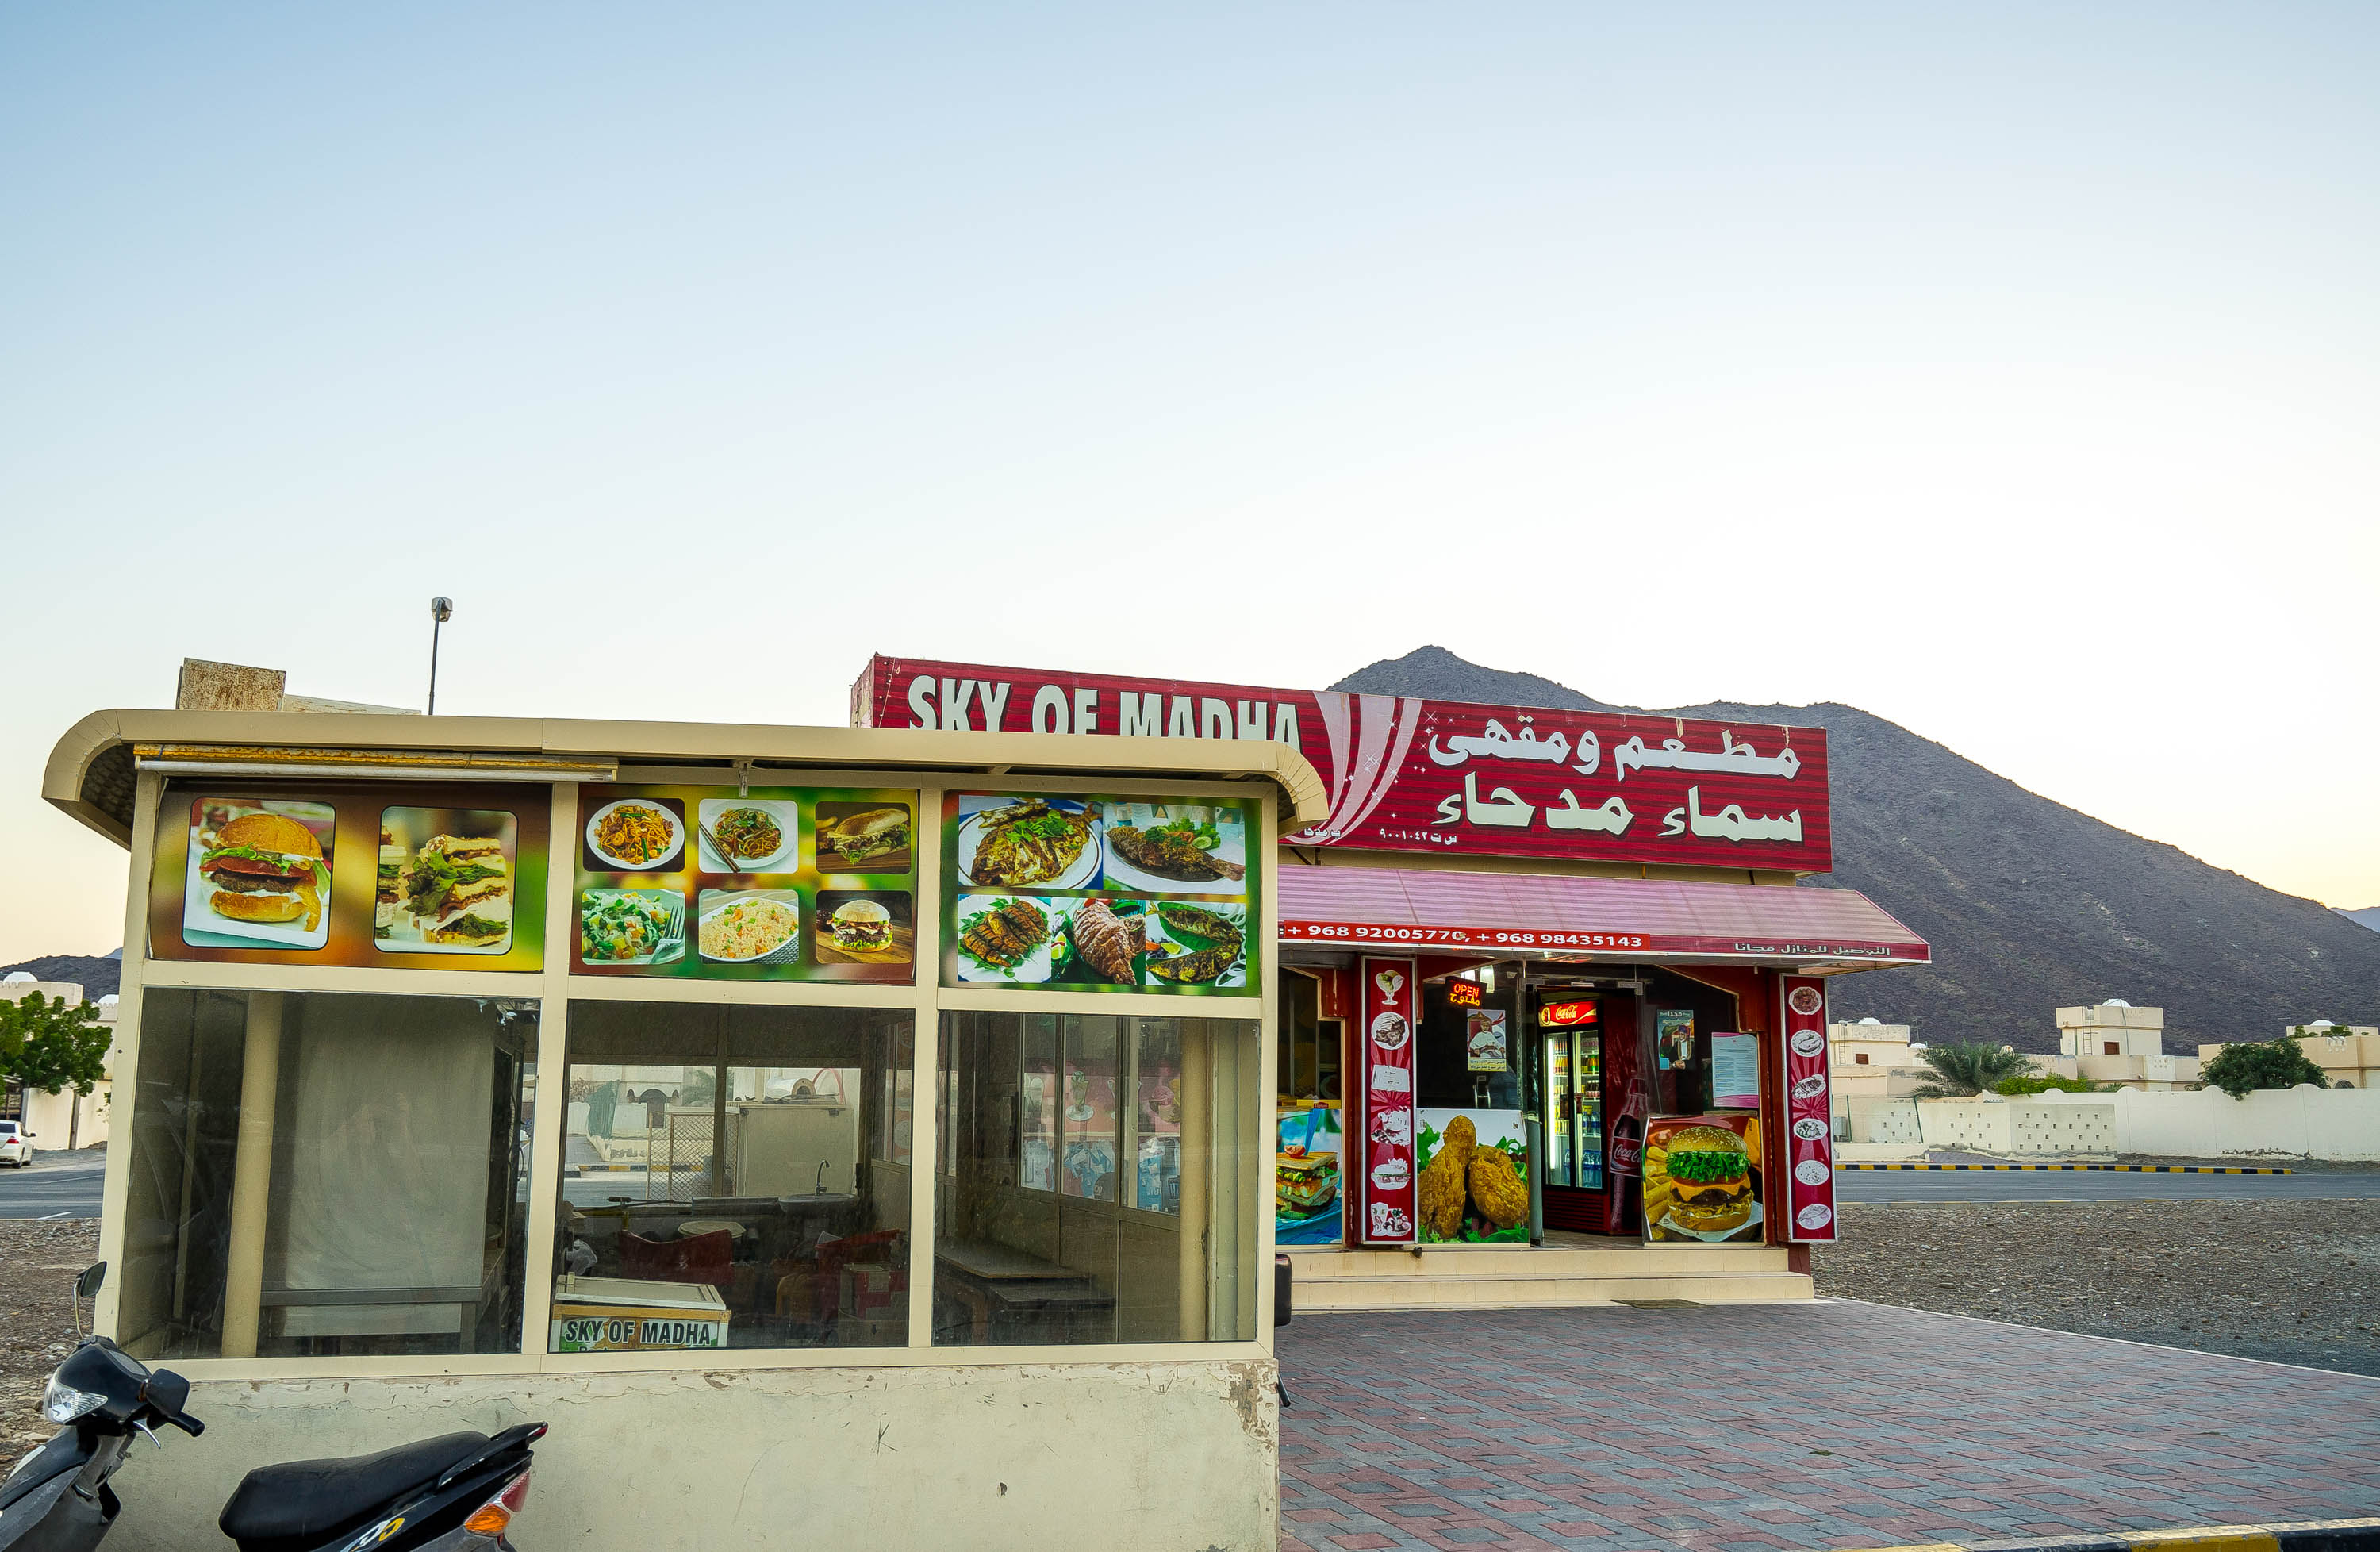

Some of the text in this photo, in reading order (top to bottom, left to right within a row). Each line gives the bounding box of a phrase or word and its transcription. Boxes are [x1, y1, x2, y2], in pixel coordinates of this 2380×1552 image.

[908, 674, 1302, 753] SKY OF MADHA
[1614, 728, 1802, 782] مطعم
[1430, 770, 1802, 842] سماء مدحاء
[1307, 925, 1349, 937] 968
[1495, 932, 1535, 943] 968
[1540, 934, 1643, 947] 98435143
[1833, 946, 1891, 956] التوصيل
[1449, 993, 1480, 1006] مفتوح
[1453, 983, 1480, 998] OPEN
[564, 1320, 712, 1346] SKY OF MADHA
